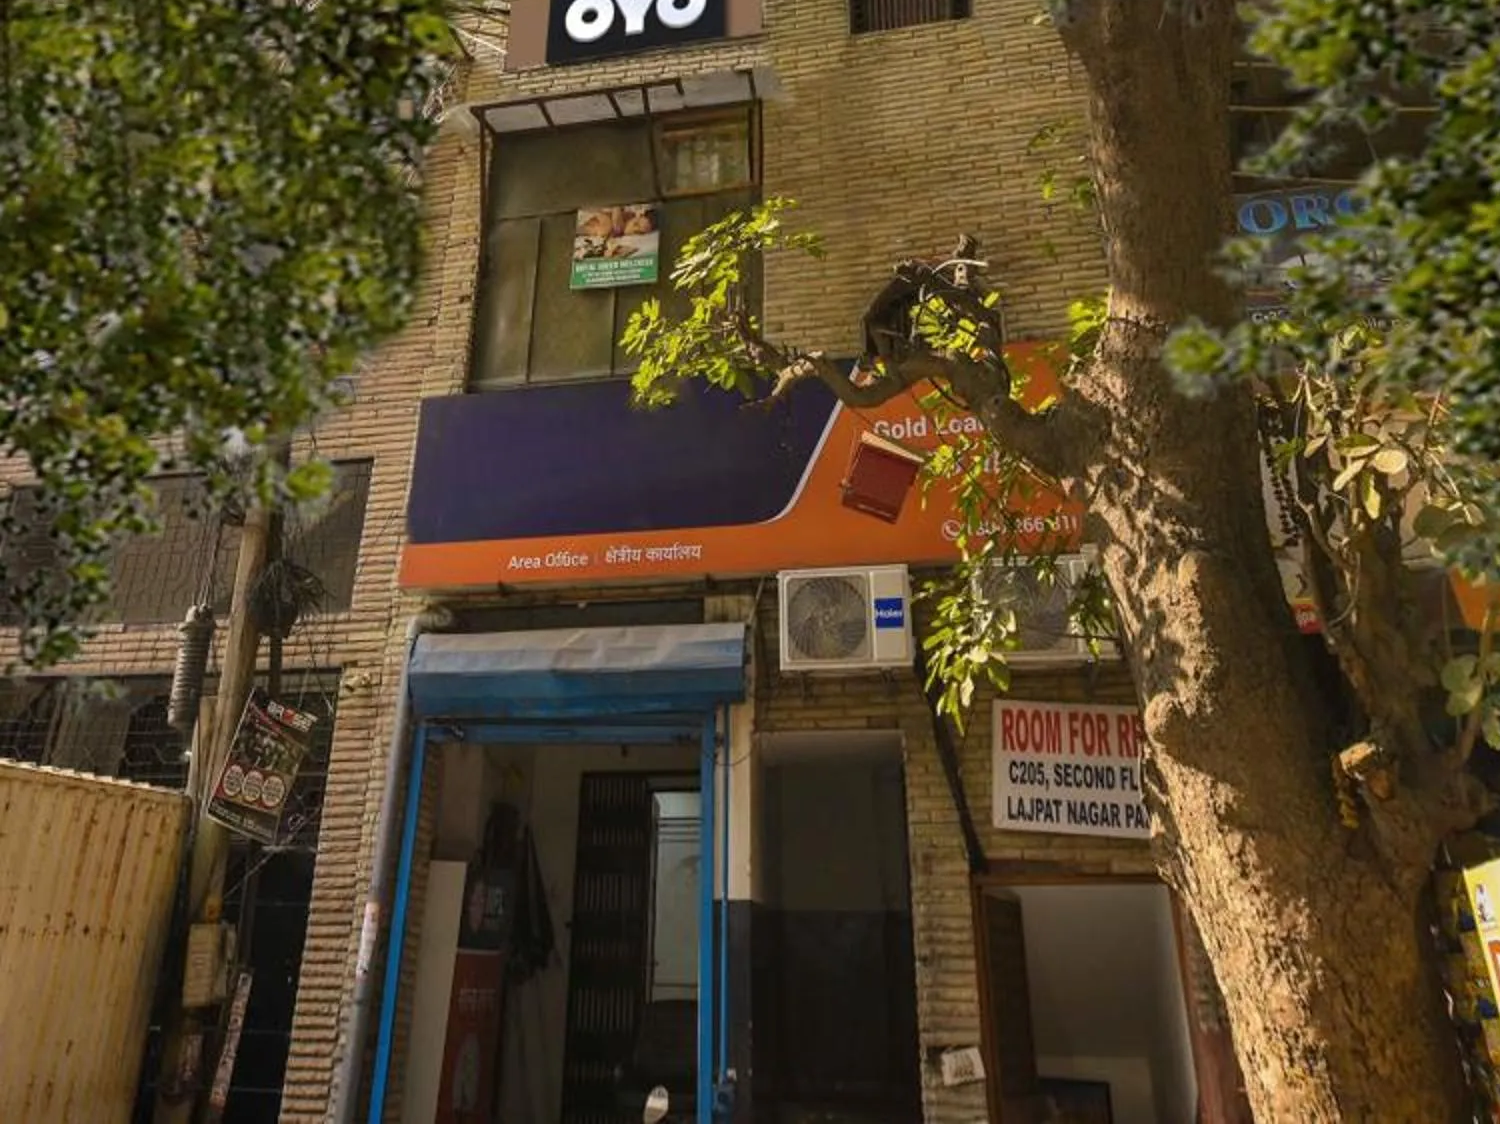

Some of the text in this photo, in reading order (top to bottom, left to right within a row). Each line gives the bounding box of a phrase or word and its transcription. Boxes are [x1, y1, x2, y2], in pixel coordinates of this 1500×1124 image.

[873, 413, 986, 440] Gold Loa
[507, 552, 589, 570] Area Office
[645, 541, 703, 563] कार्यालय
[1001, 708, 1063, 755] ROOM
[1068, 711, 1112, 758] FOR
[1009, 760, 1050, 791] C205,
[1053, 763, 1116, 790] SECOND
[1007, 796, 1063, 824] LAJPAT
[1066, 799, 1121, 829] NAGAR
